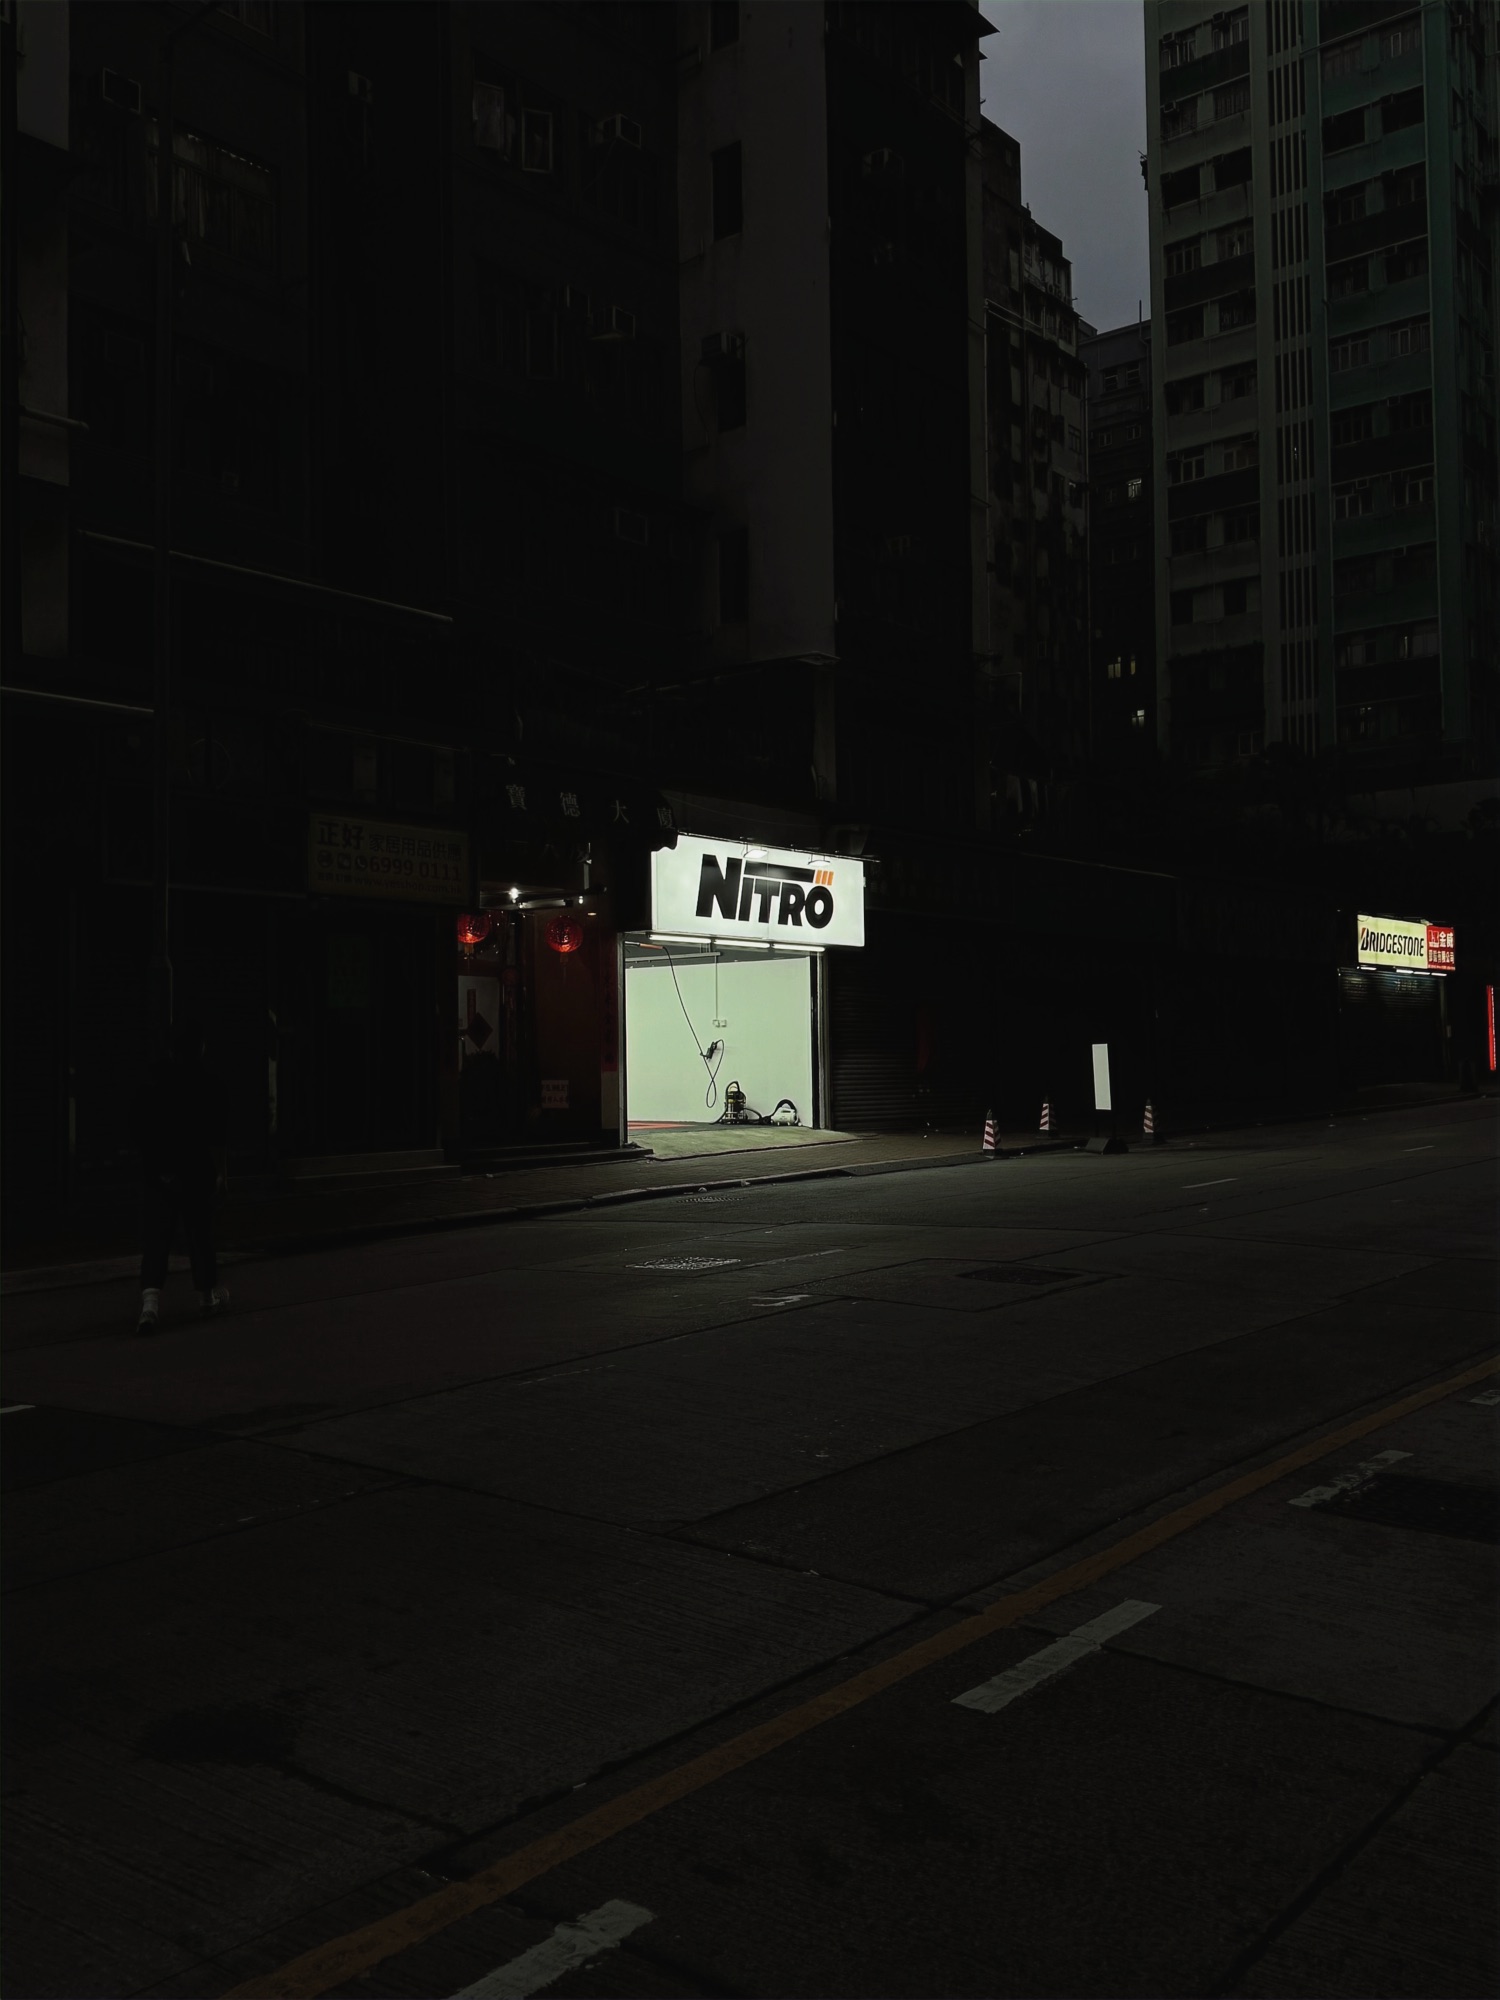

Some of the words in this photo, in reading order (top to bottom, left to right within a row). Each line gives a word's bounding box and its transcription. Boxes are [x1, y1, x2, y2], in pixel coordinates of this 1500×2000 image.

[318, 821, 364, 850] 正好
[370, 856, 413, 876] 6999
[419, 861, 462, 882] 0111
[1360, 927, 1425, 957] BRIDGESTONE
